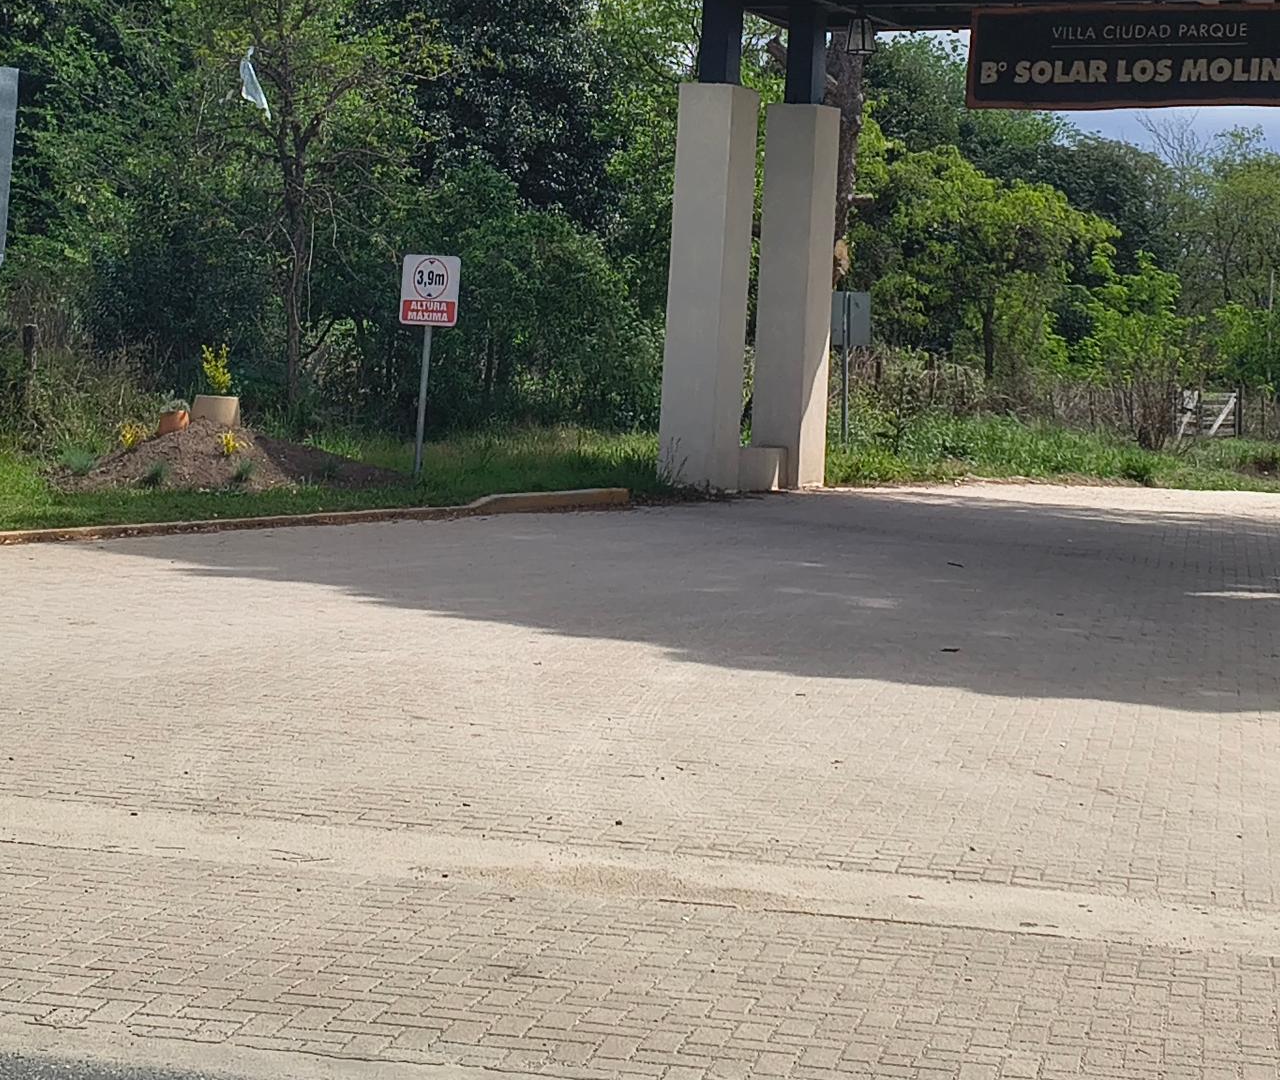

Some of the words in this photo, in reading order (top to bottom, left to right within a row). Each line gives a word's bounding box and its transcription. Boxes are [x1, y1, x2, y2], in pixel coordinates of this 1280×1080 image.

[1052, 26, 1096, 40] VILLA
[1103, 24, 1171, 39] CIUDAD
[1178, 23, 1248, 38] PARQUE
[1013, 59, 1108, 84] SOLAR
[1116, 58, 1173, 83] LOS
[417, 270, 445, 287] 3,9m
[410, 301, 447, 311] ALTURA
